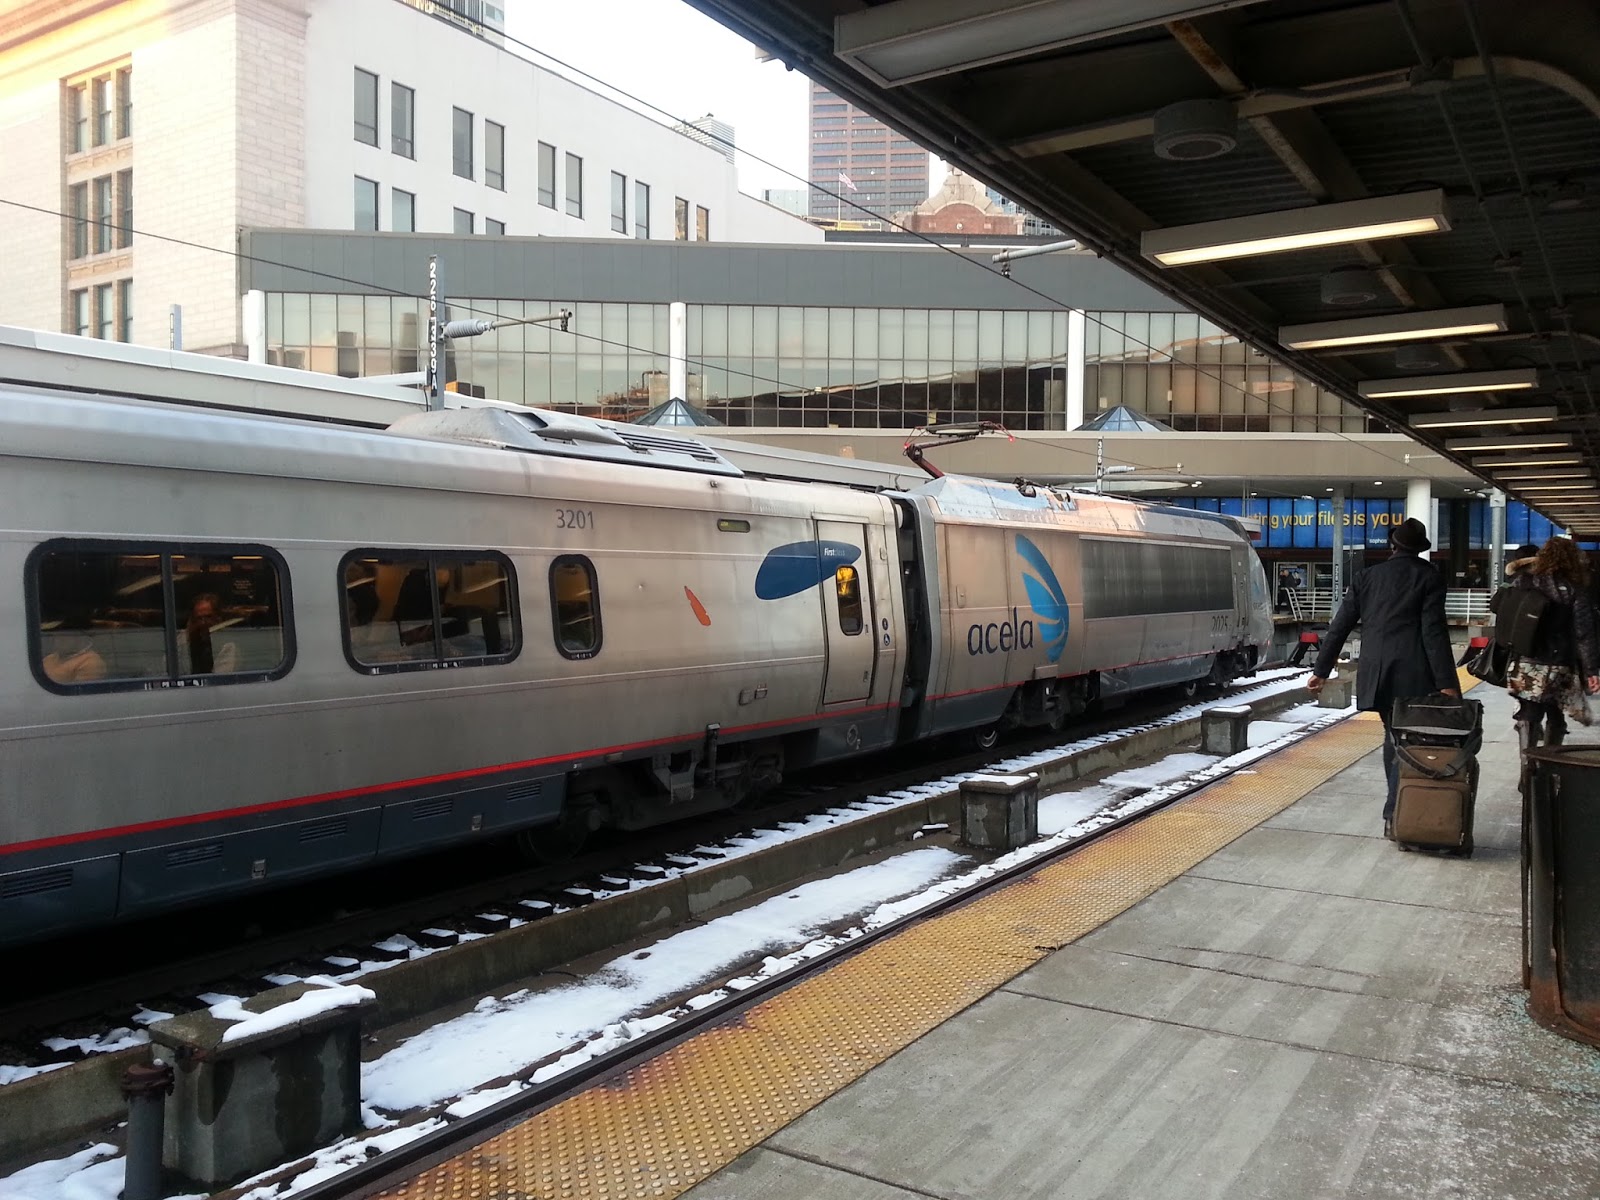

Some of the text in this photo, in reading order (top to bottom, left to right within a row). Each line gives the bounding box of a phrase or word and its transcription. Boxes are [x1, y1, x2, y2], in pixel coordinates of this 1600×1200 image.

[556, 508, 594, 529] 3201
[1282, 514, 1314, 529] your
[1353, 510, 1365, 526] is
[1369, 537, 1387, 545] sophos
[824, 547, 835, 556] First
[967, 606, 1034, 656] acela
